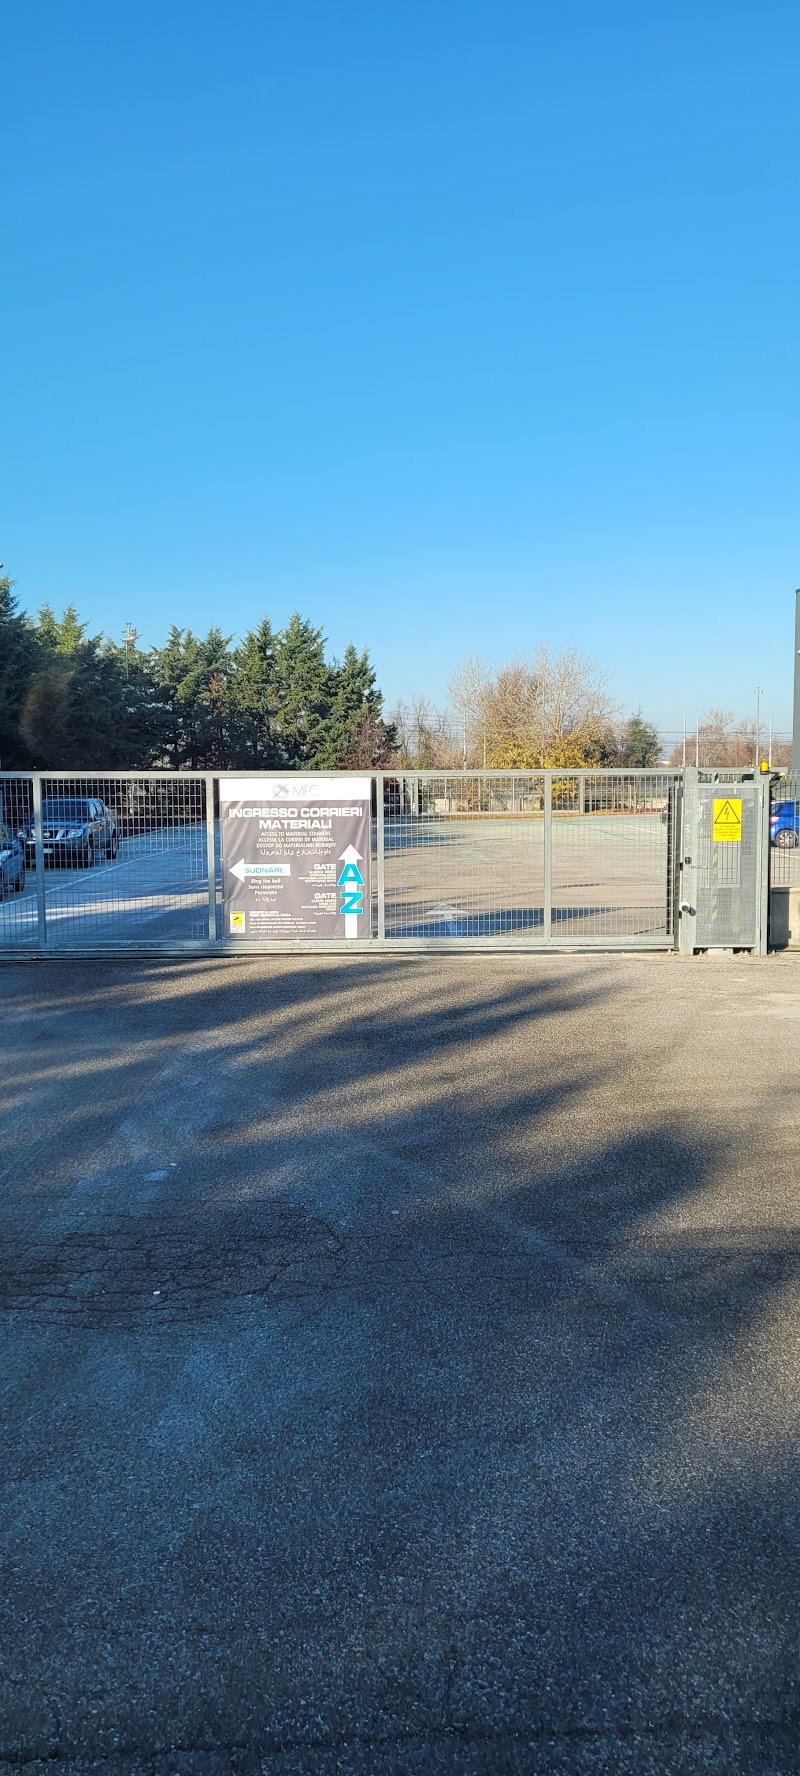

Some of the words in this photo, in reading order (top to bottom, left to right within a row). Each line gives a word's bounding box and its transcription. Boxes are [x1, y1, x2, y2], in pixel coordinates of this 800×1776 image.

[292, 784, 319, 797] MEC
[228, 807, 298, 819] INGRESSO
[300, 807, 363, 818] CORRIERI
[258, 818, 332, 829] MATERIALI
[337, 863, 365, 887] A
[340, 891, 363, 915] Z
